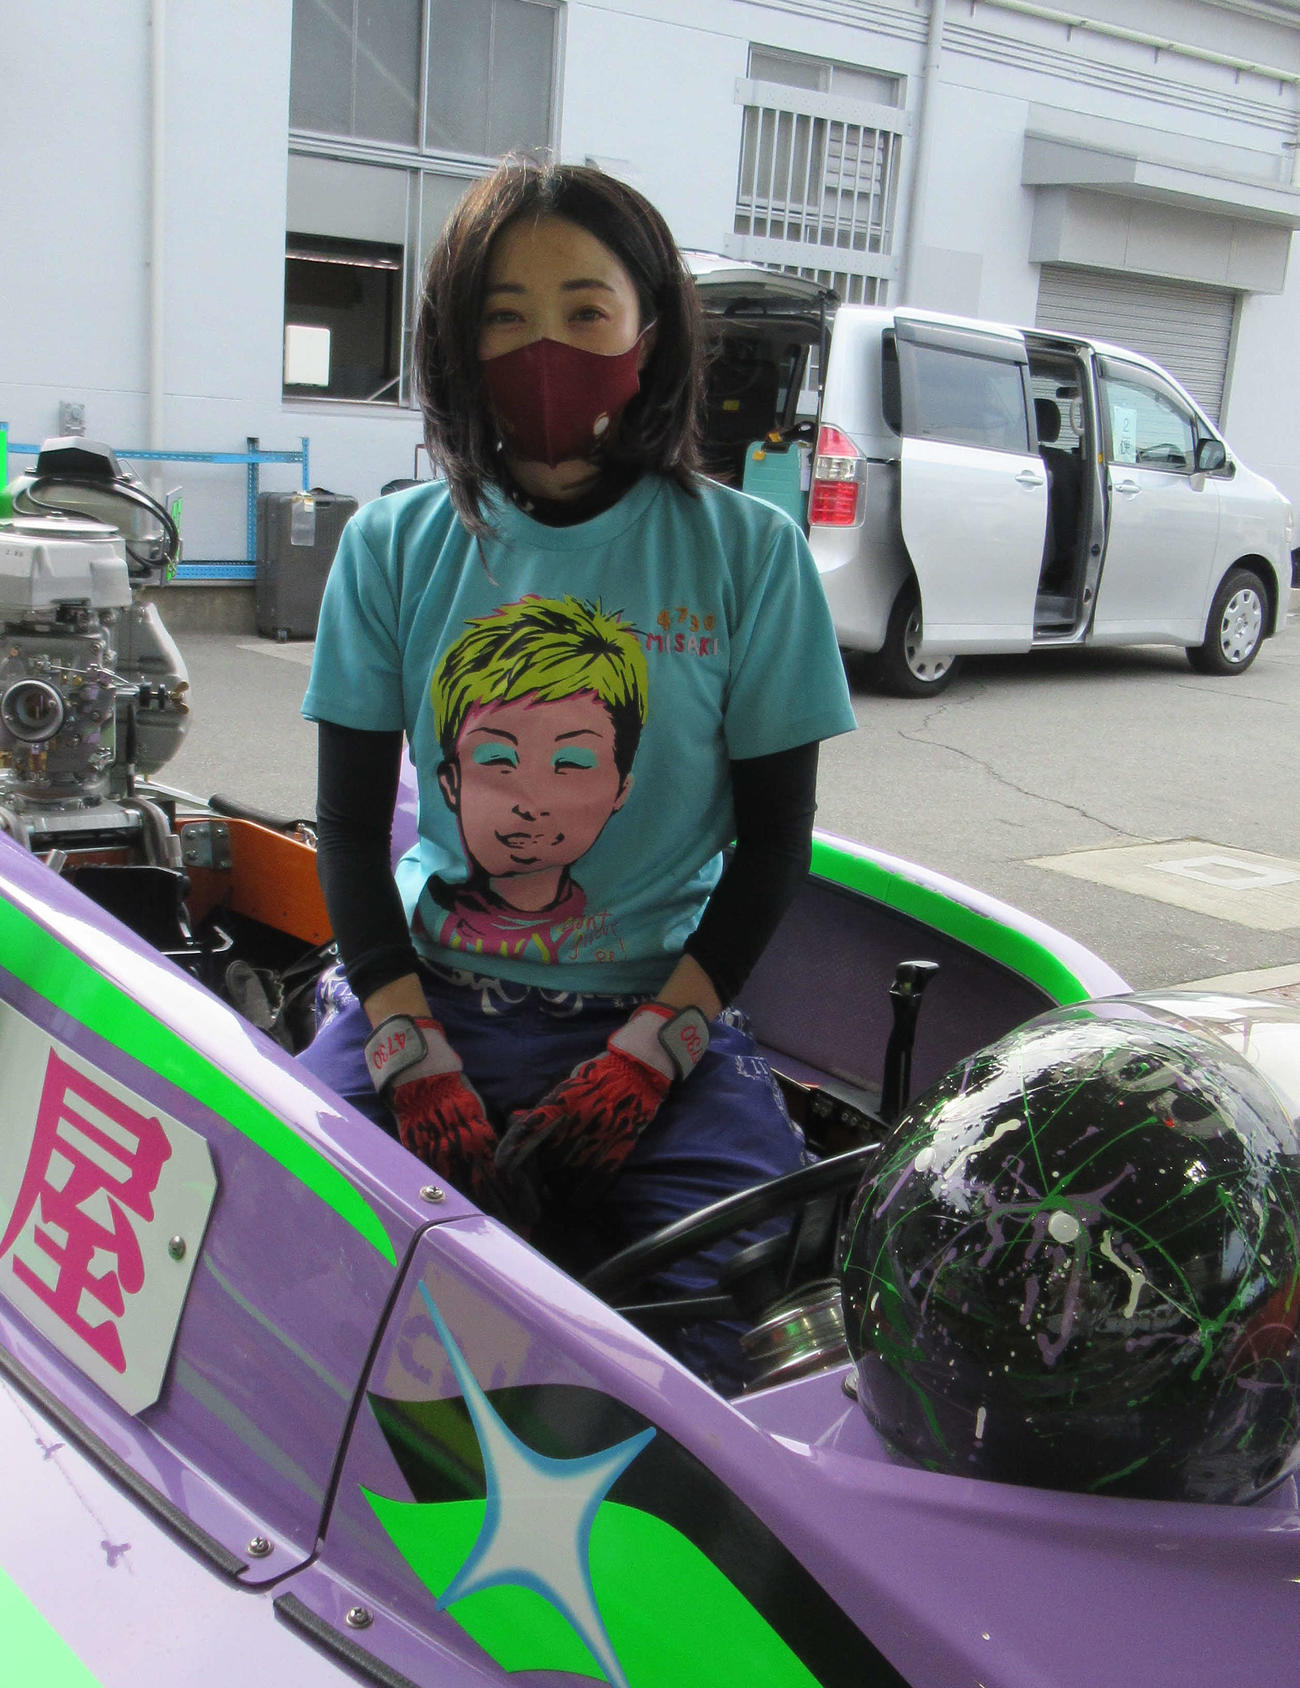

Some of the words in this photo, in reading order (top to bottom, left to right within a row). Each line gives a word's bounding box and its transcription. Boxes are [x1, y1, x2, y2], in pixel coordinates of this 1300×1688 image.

[657, 607, 716, 632] 4730
[646, 633, 719, 656] MISAKI
[373, 1032, 406, 1069] 4730
